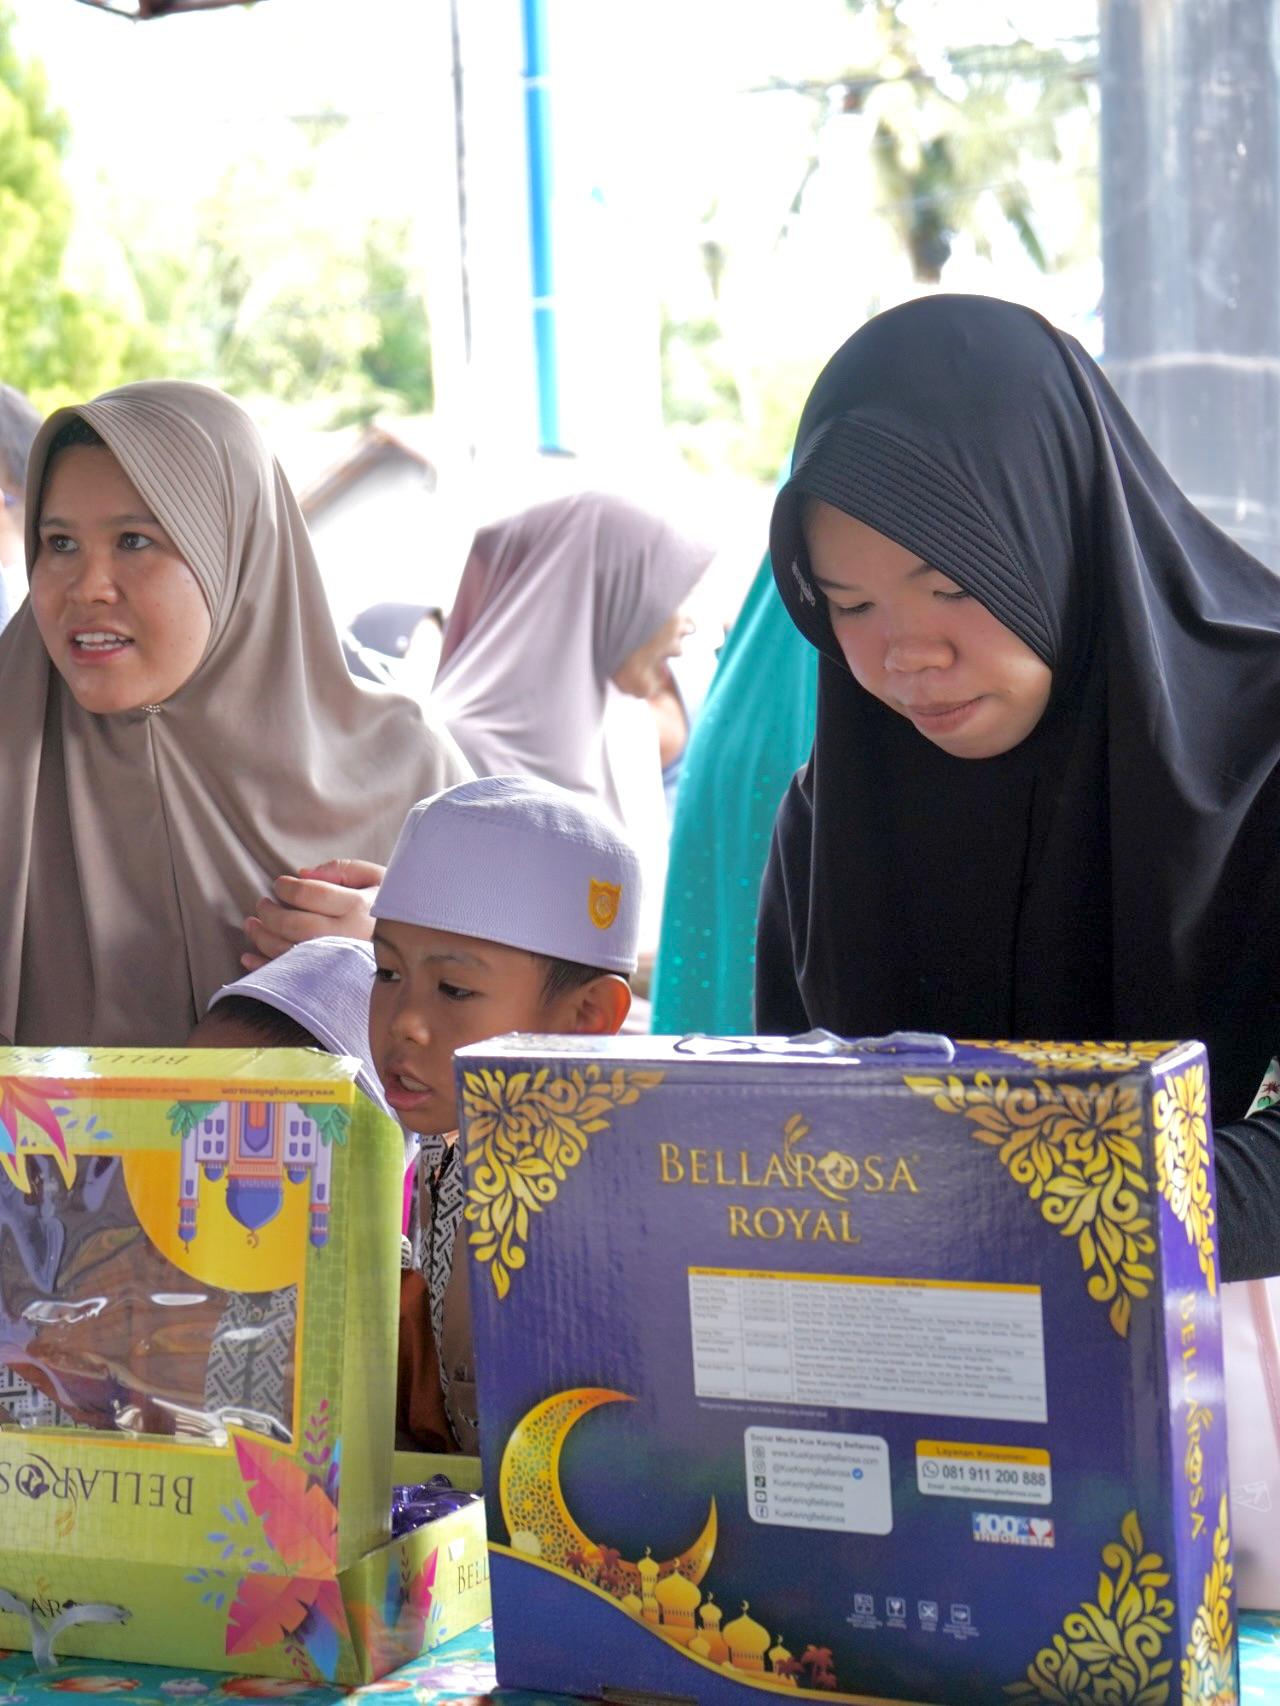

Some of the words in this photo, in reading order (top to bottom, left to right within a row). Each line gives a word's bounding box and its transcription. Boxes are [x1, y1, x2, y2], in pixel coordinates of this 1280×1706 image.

[658, 1142, 919, 1202] BELLAROSA
[728, 1205, 862, 1244] ROYAL
[942, 1464, 964, 1480] 081
[969, 1467, 991, 1483] 911
[996, 1470, 1019, 1485] 200
[1022, 1471, 1047, 1487] 888
[457, 1556, 490, 1595] BELL
